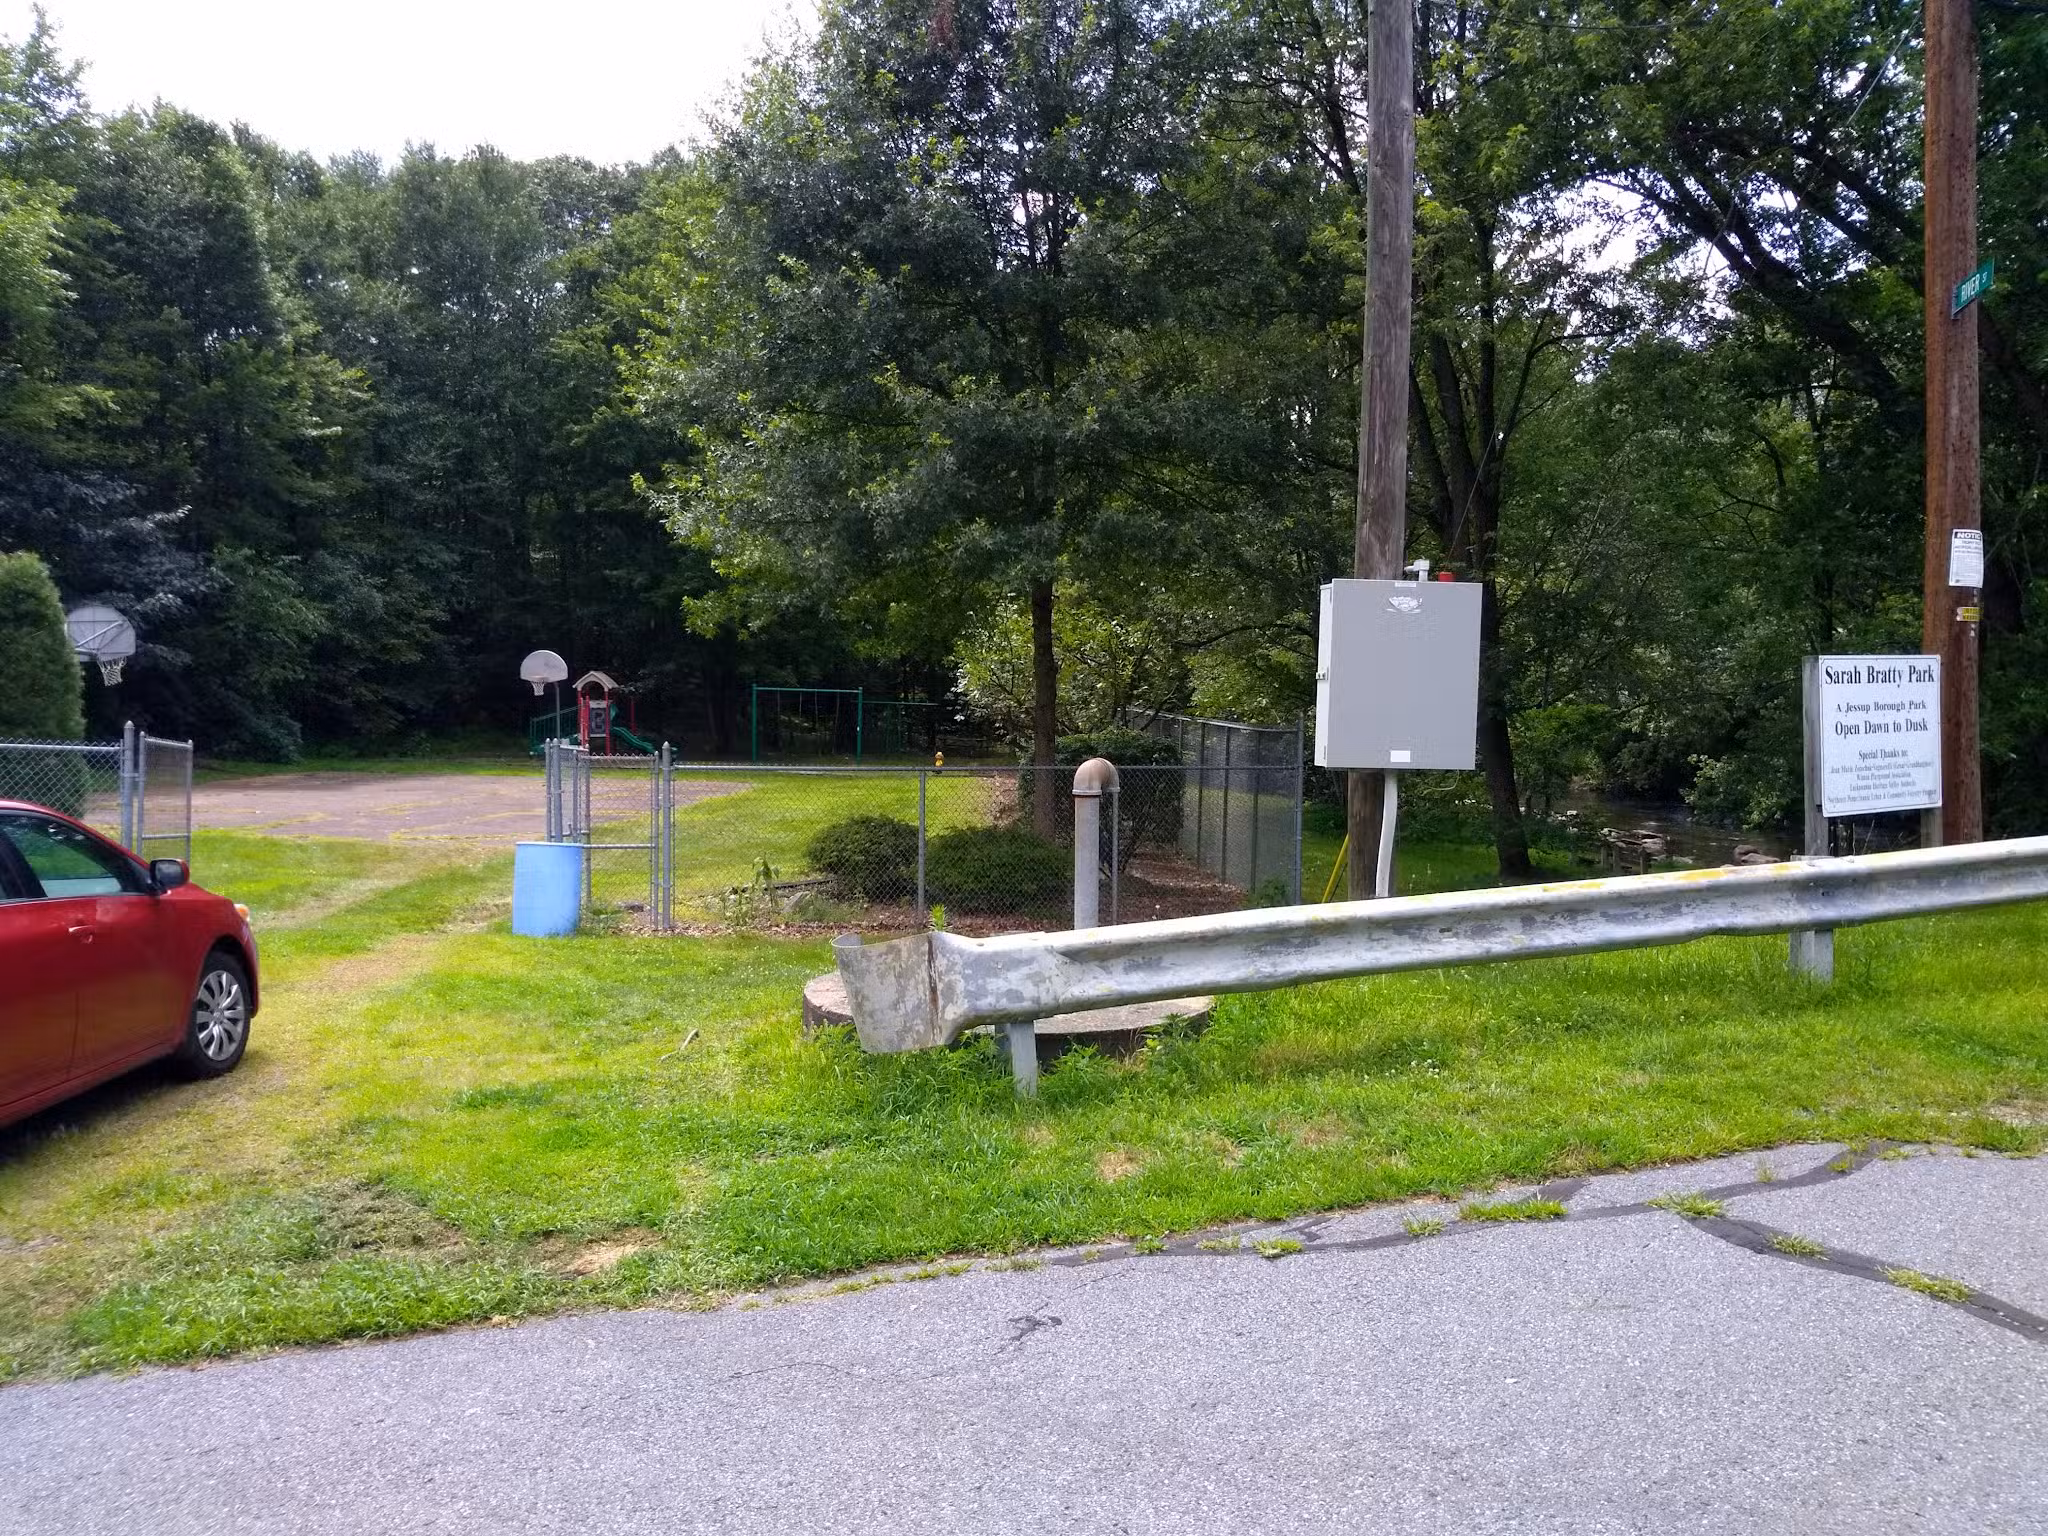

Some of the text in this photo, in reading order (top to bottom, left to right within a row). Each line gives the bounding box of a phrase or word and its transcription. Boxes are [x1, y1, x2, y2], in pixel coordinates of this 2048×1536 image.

[1961, 274, 1980, 302] RIVER
[1957, 532, 1981, 540] NOTIC
[1825, 664, 1935, 688] Sarah Bratty Park
[1836, 700, 1927, 714] A Jessup Borough Park
[1835, 718, 1928, 739] Open Dawn to Dusk
[1858, 749, 1878, 762] Special
[1879, 748, 1900, 760] Thanks
